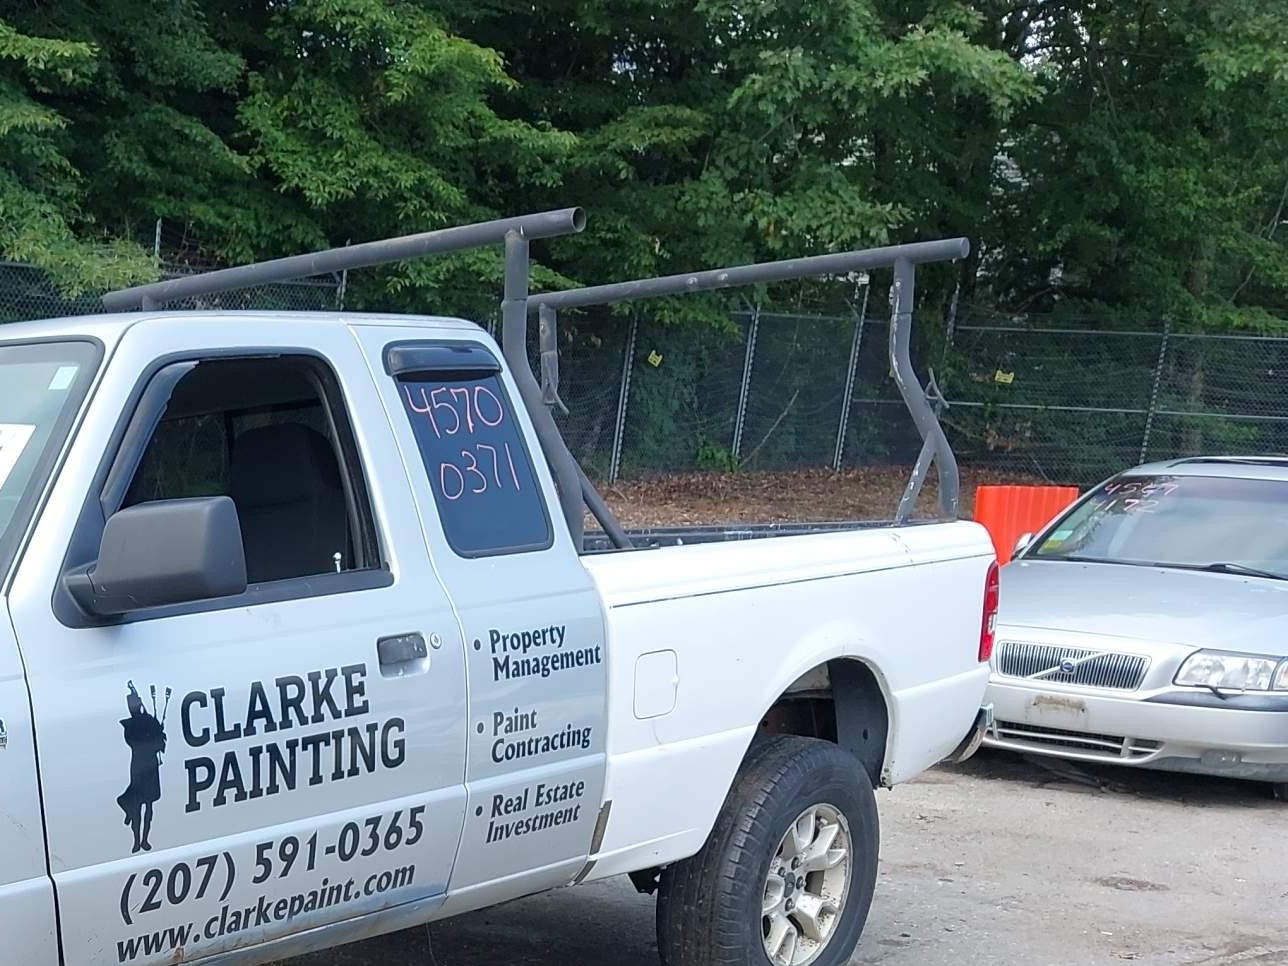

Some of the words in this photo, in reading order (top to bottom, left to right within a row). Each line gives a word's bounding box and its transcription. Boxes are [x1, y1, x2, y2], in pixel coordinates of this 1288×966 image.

[403, 384, 503, 439] 4570
[440, 442, 520, 500] 0371
[489, 625, 566, 654] Property
[492, 644, 602, 681] Management
[181, 663, 369, 747] CLARKE
[493, 707, 537, 736] Paint
[184, 717, 405, 813] PAINTING
[492, 723, 592, 763] Contracting
[491, 788, 529, 818] Real
[535, 781, 585, 807] Estate
[486, 804, 581, 843] Investment
[120, 852, 236, 925] (207)
[252, 805, 425, 884] 591-0365
[117, 864, 416, 963] www.clarkepaint.com
